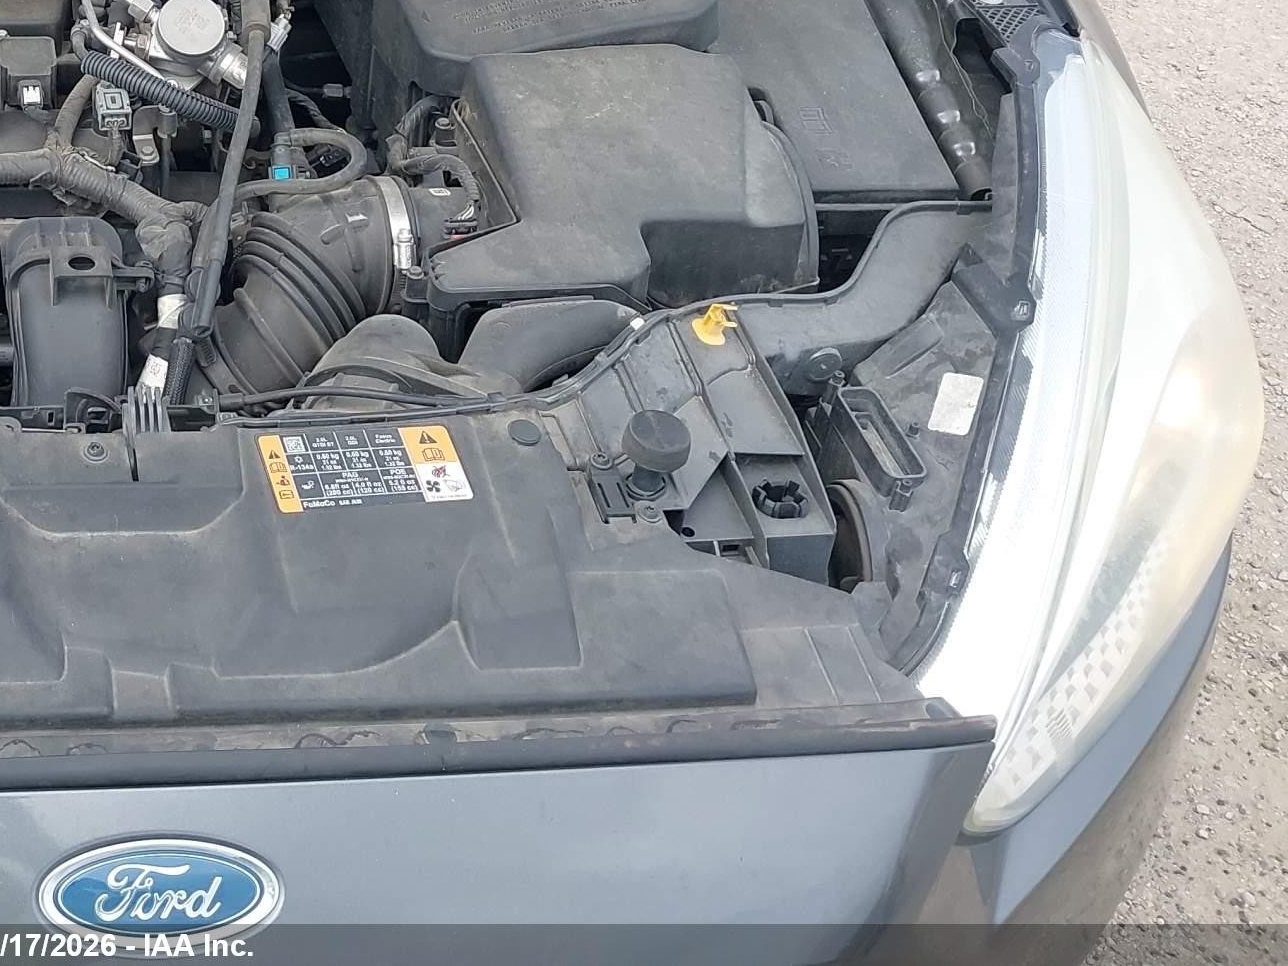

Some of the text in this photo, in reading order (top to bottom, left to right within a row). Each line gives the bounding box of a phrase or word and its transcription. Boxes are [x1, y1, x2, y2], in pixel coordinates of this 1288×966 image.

[341, 471, 359, 479] PAG
[303, 499, 336, 508] FoMoCo
[95, 863, 223, 923] Ford
